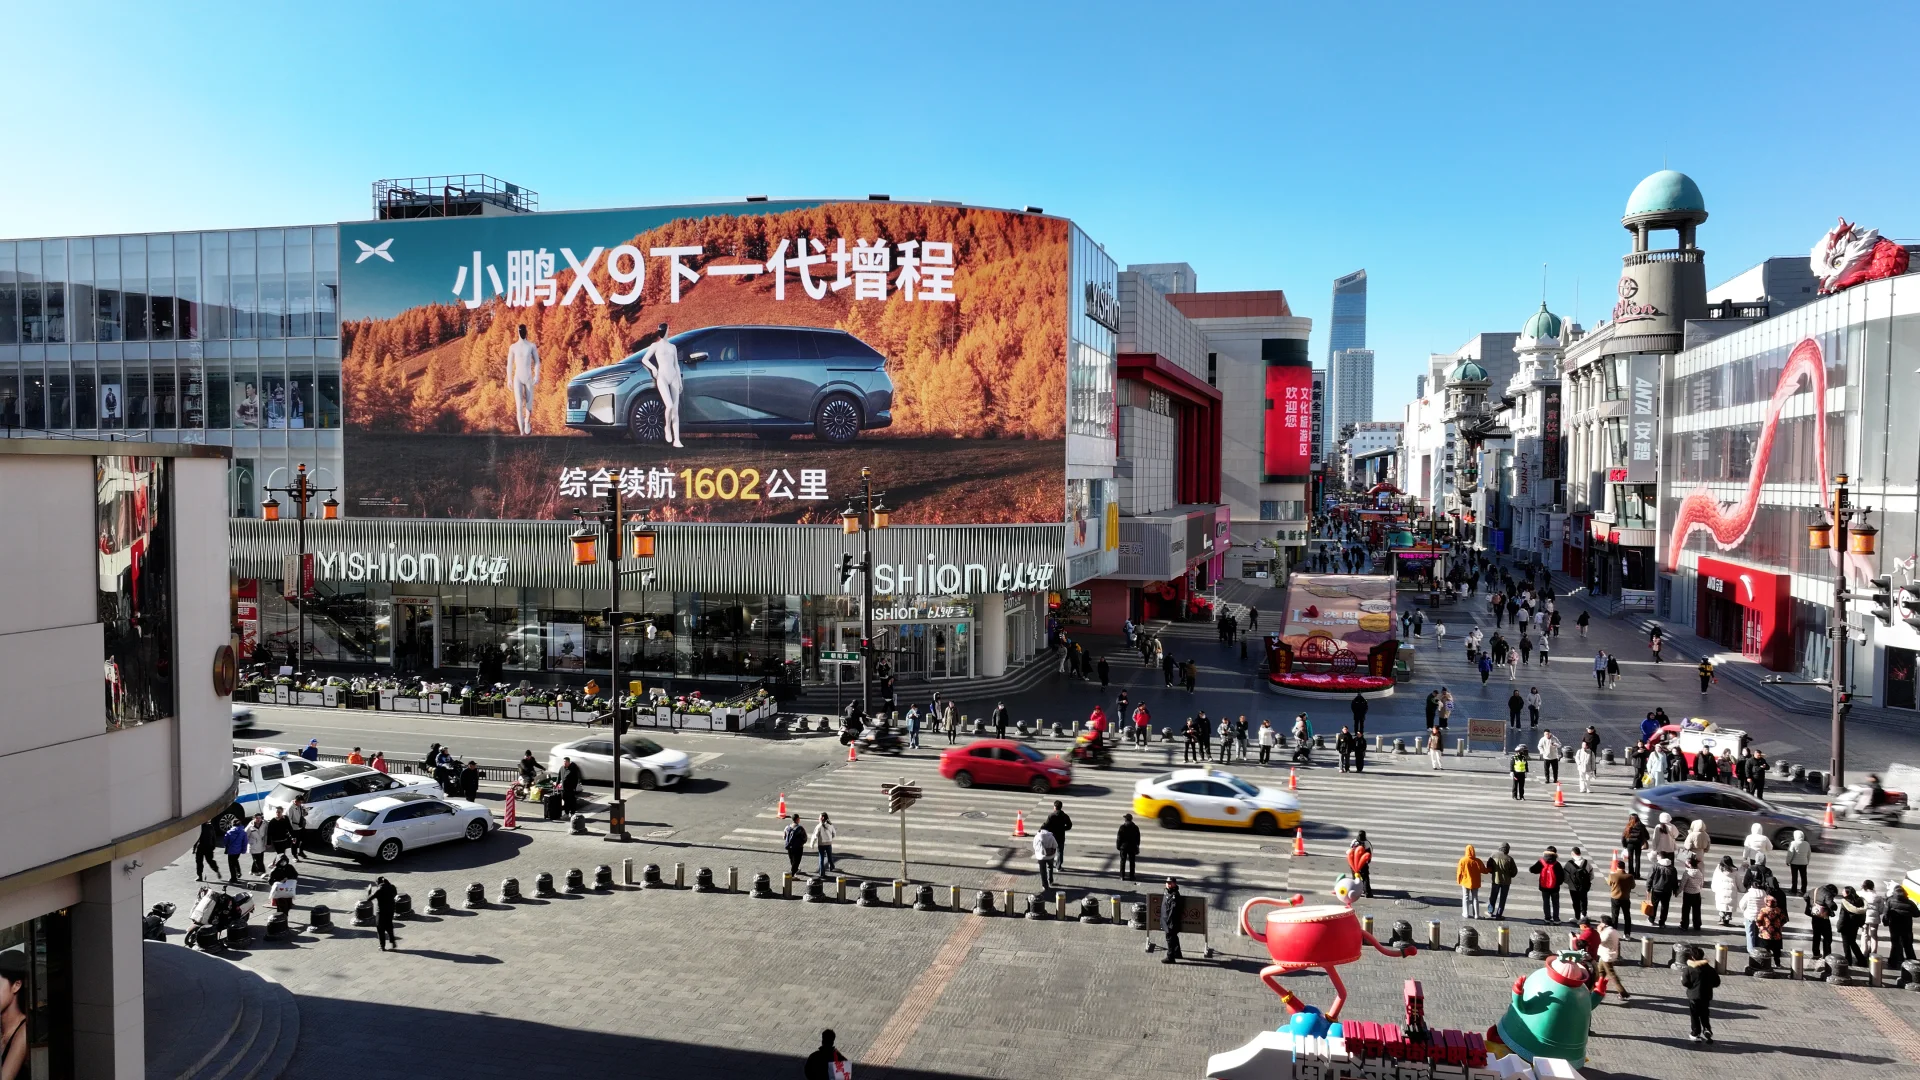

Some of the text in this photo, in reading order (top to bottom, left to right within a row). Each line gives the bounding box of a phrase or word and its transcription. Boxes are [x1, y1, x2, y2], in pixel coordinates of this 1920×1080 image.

[452, 238, 957, 310] 小鹏X9下一代增程
[1284, 386, 1298, 428] 欢迎您
[1634, 376, 1653, 415] ANTA
[1299, 387, 1309, 456] 文化旅游区
[1609, 469, 1627, 482] KF
[449, 554, 510, 584] 以纯
[996, 562, 1056, 592] 以纯
